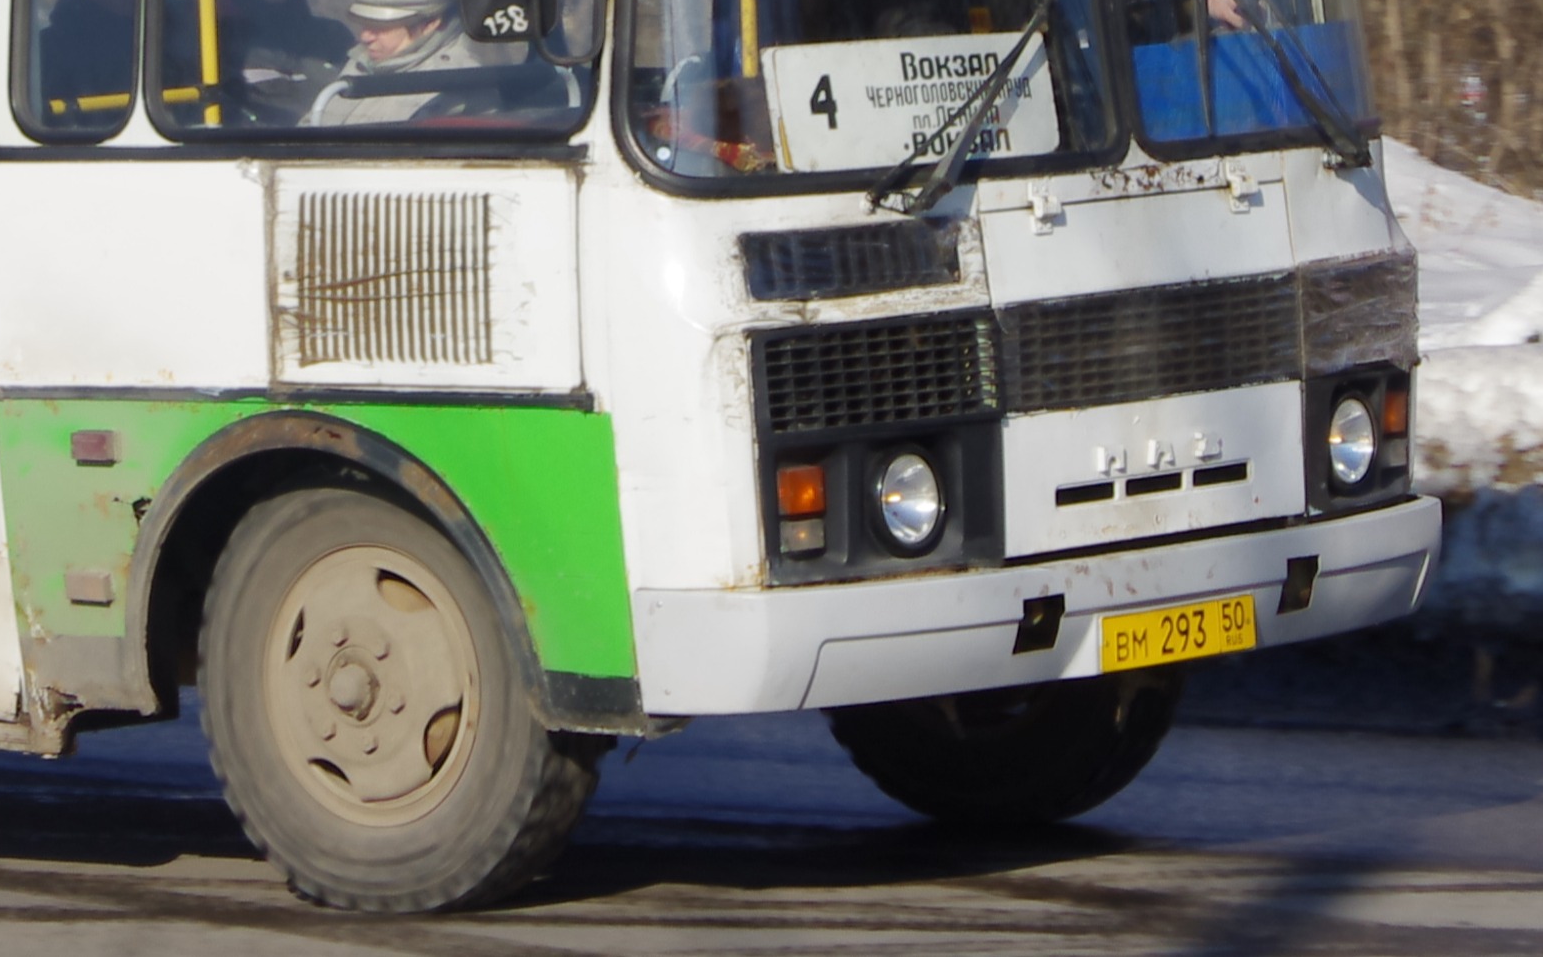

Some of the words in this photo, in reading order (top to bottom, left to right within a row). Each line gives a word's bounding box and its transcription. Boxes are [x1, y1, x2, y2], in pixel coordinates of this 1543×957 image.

[483, 4, 529, 37] 158
[809, 74, 838, 131] 4
[912, 104, 1002, 130] пл.ЛЕНА
[1160, 609, 1207, 655] 293
[1221, 601, 1245, 632] 50
[1225, 633, 1244, 646] RUS
